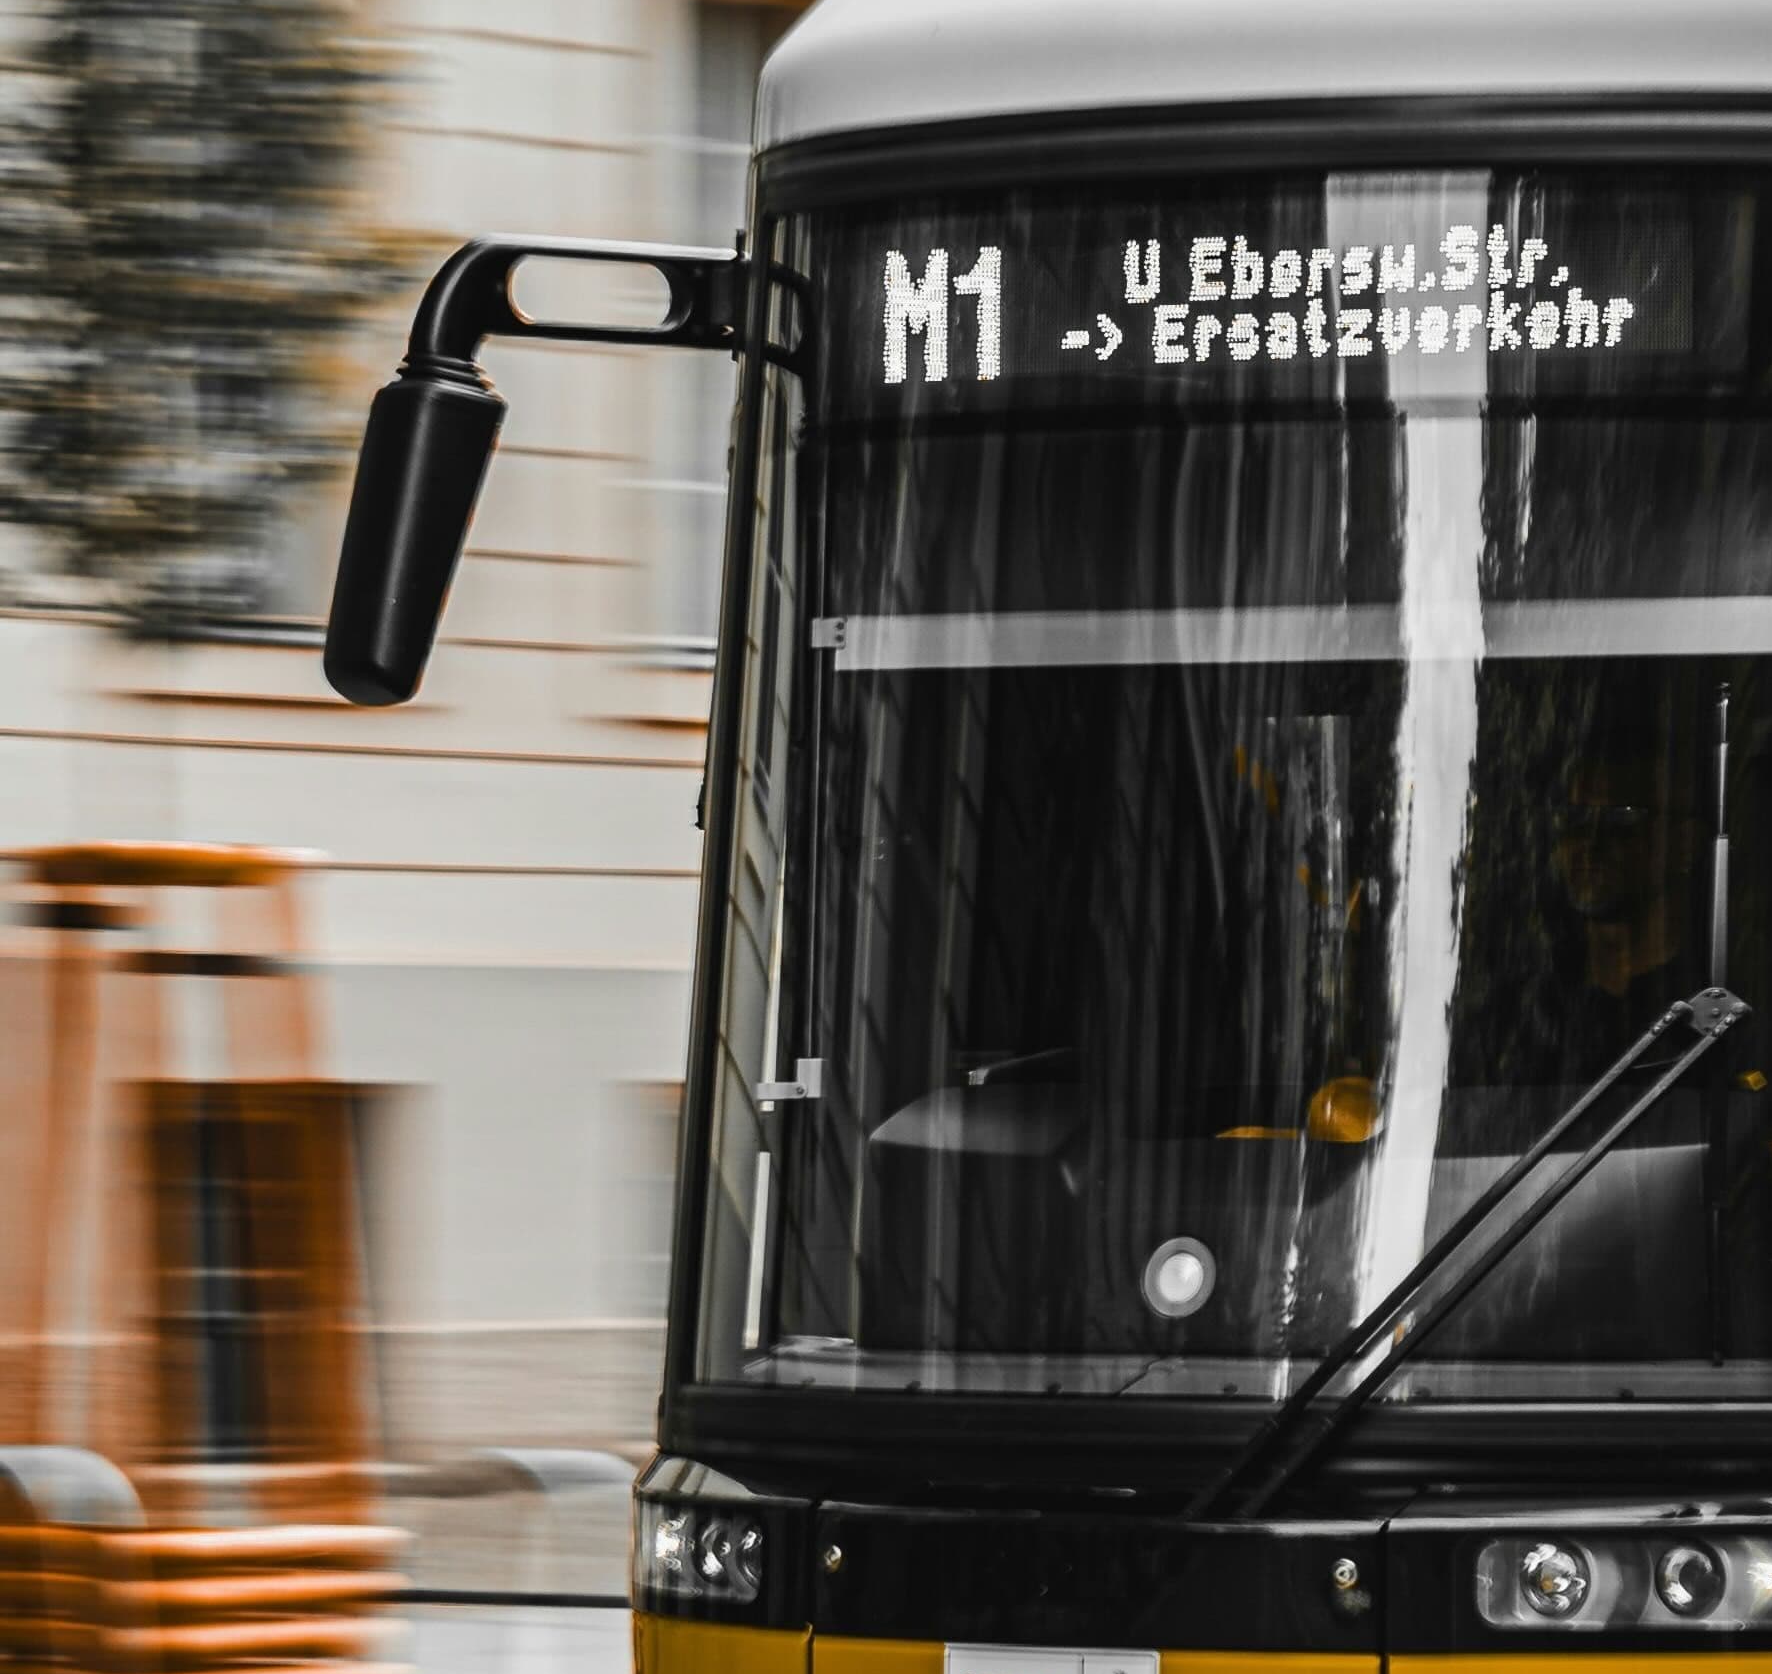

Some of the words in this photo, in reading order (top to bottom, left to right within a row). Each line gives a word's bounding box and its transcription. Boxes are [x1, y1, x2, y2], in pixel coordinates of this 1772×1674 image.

[1123, 239, 1160, 304] U
[883, 246, 1001, 384] M1
[1151, 287, 1634, 363] Ersatzverkehr
